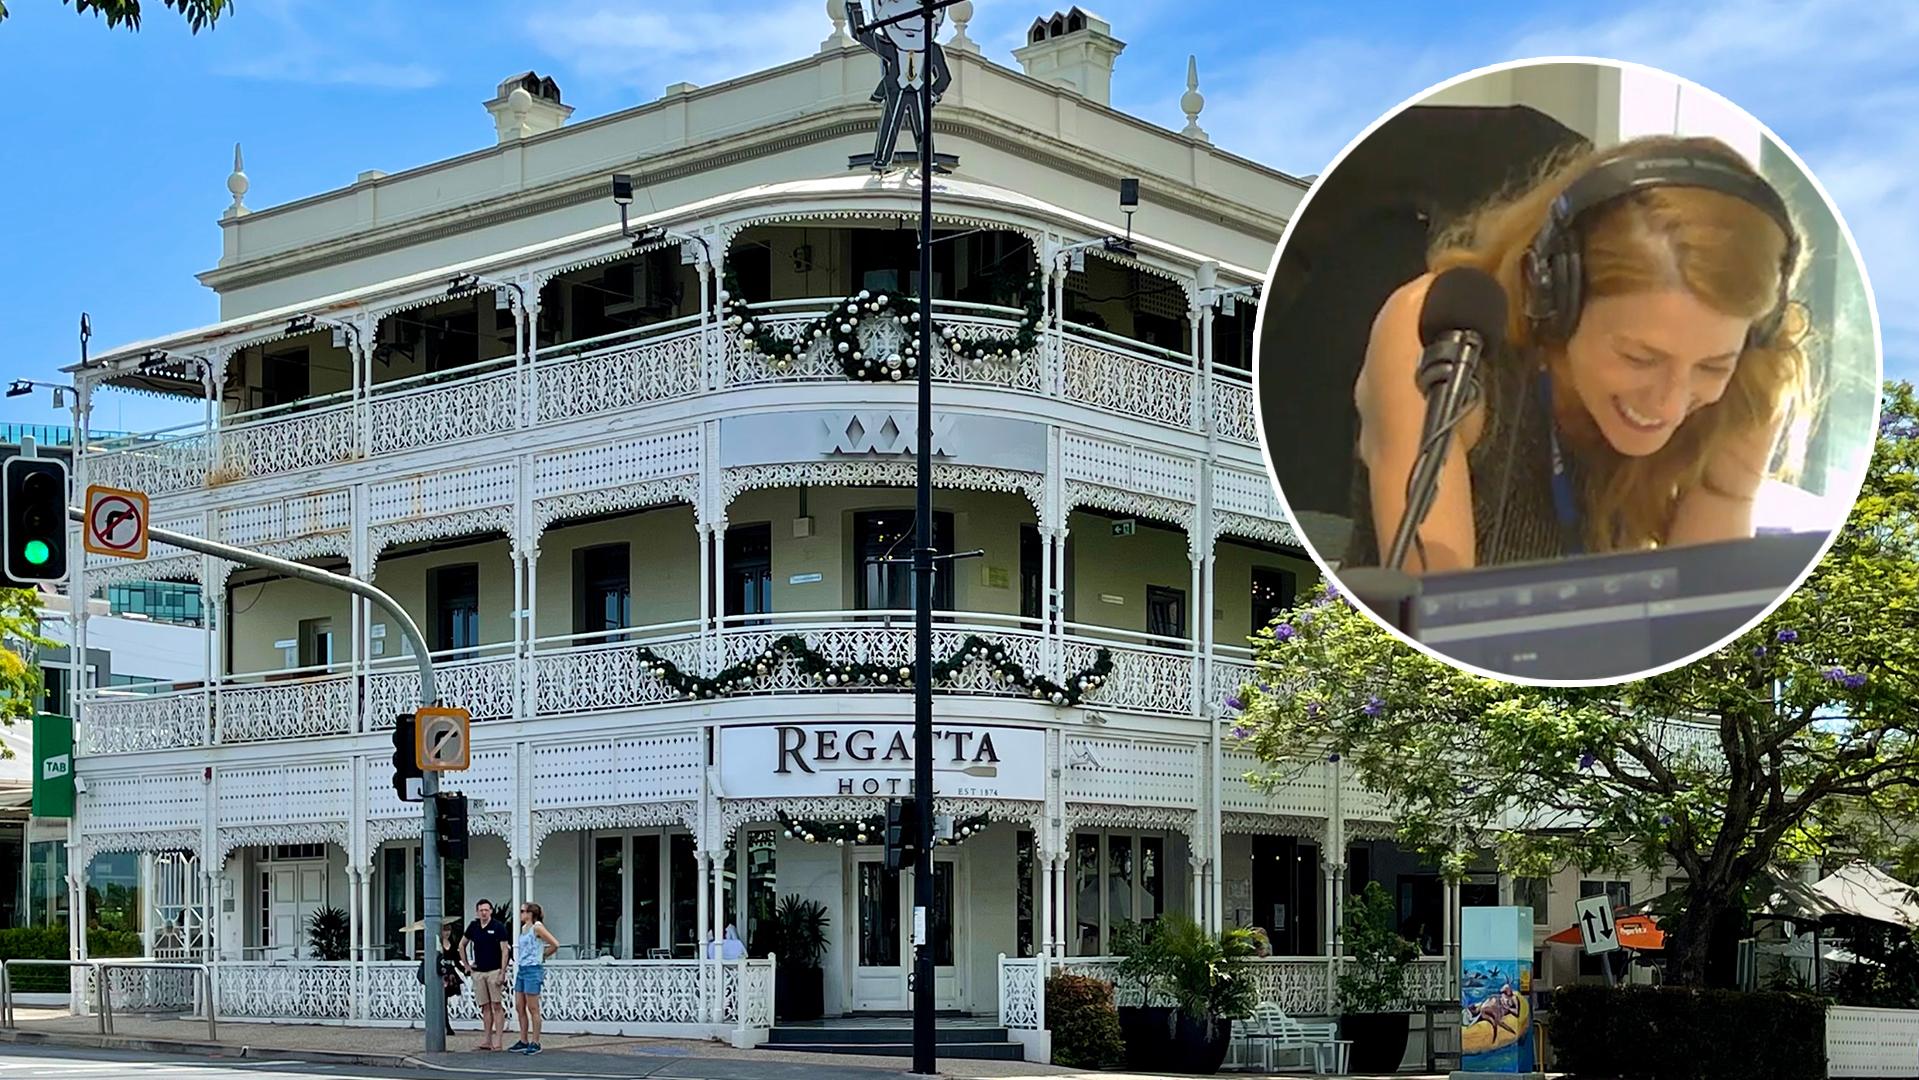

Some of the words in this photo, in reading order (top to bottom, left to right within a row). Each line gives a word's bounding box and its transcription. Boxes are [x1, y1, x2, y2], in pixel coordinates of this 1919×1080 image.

[46, 761, 67, 773] TAB
[838, 777, 940, 795] HOT
[958, 788, 977, 796] EST
